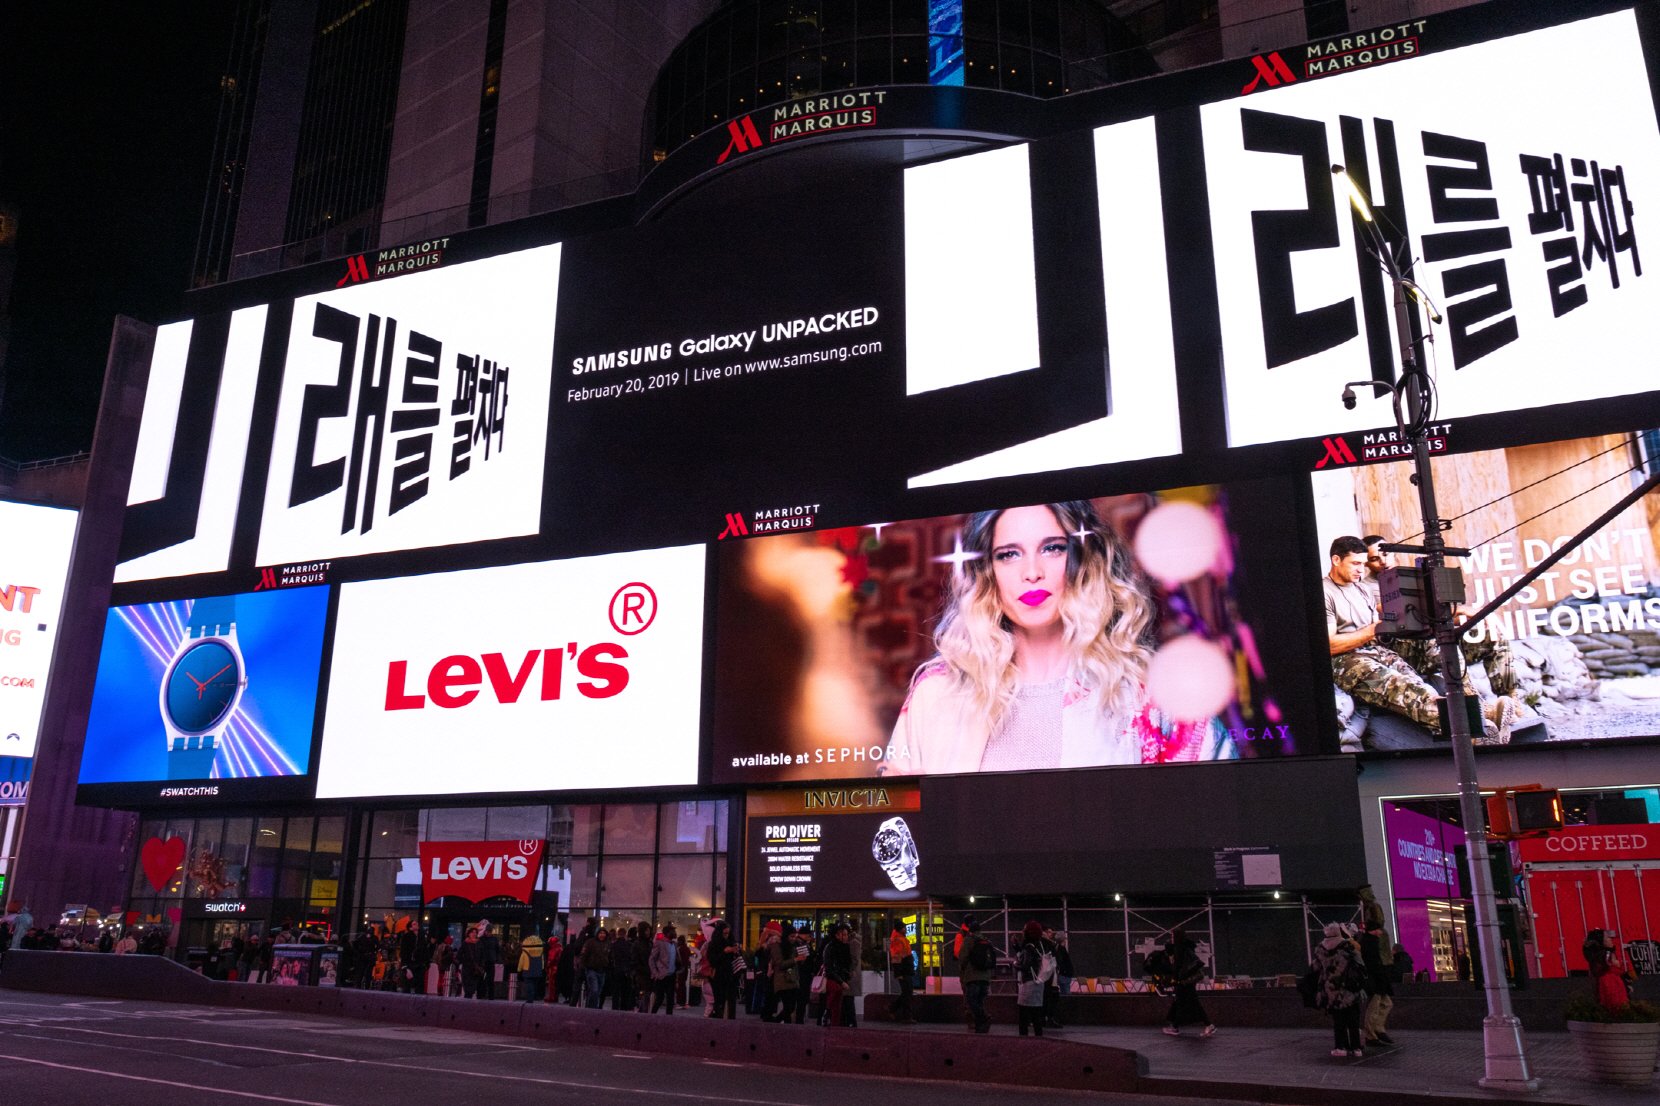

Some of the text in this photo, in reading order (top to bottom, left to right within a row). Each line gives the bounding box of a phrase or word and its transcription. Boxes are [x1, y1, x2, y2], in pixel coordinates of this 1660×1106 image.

[1307, 20, 1427, 58] MARRIOTT
[1309, 41, 1415, 76] MARQUIS
[774, 91, 887, 121] MARRIOTT
[773, 110, 873, 140] MARQUIS
[1519, 152, 1643, 319] 펼치다
[379, 238, 450, 262] MARRIOTT
[377, 253, 439, 275] MARQUIS
[571, 306, 879, 376] SAMSUNG Galaxy UNPACKED
[567, 340, 882, 403] February 20, 2019 Live on www.samsung.com
[448, 352, 510, 481] 펼치다
[1363, 424, 1452, 446] MARTT
[1365, 438, 1444, 458] MARQIS
[755, 504, 820, 520] MARRIOTT
[755, 517, 812, 532] MARQUIS
[1459, 527, 1648, 575] WE DON'T
[281, 573, 324, 585] MARQUIS
[282, 562, 331, 575] MARRIOTT
[1471, 563, 1648, 610] JUST SEE
[731, 745, 912, 767] available at SEPHORA
[160, 786, 219, 797] #SWATCHTHIS
[804, 788, 891, 808] INVICTA
[765, 824, 821, 838] PRO DIVER
[1546, 835, 1648, 852] COFFEED
[205, 902, 240, 912] swatch
